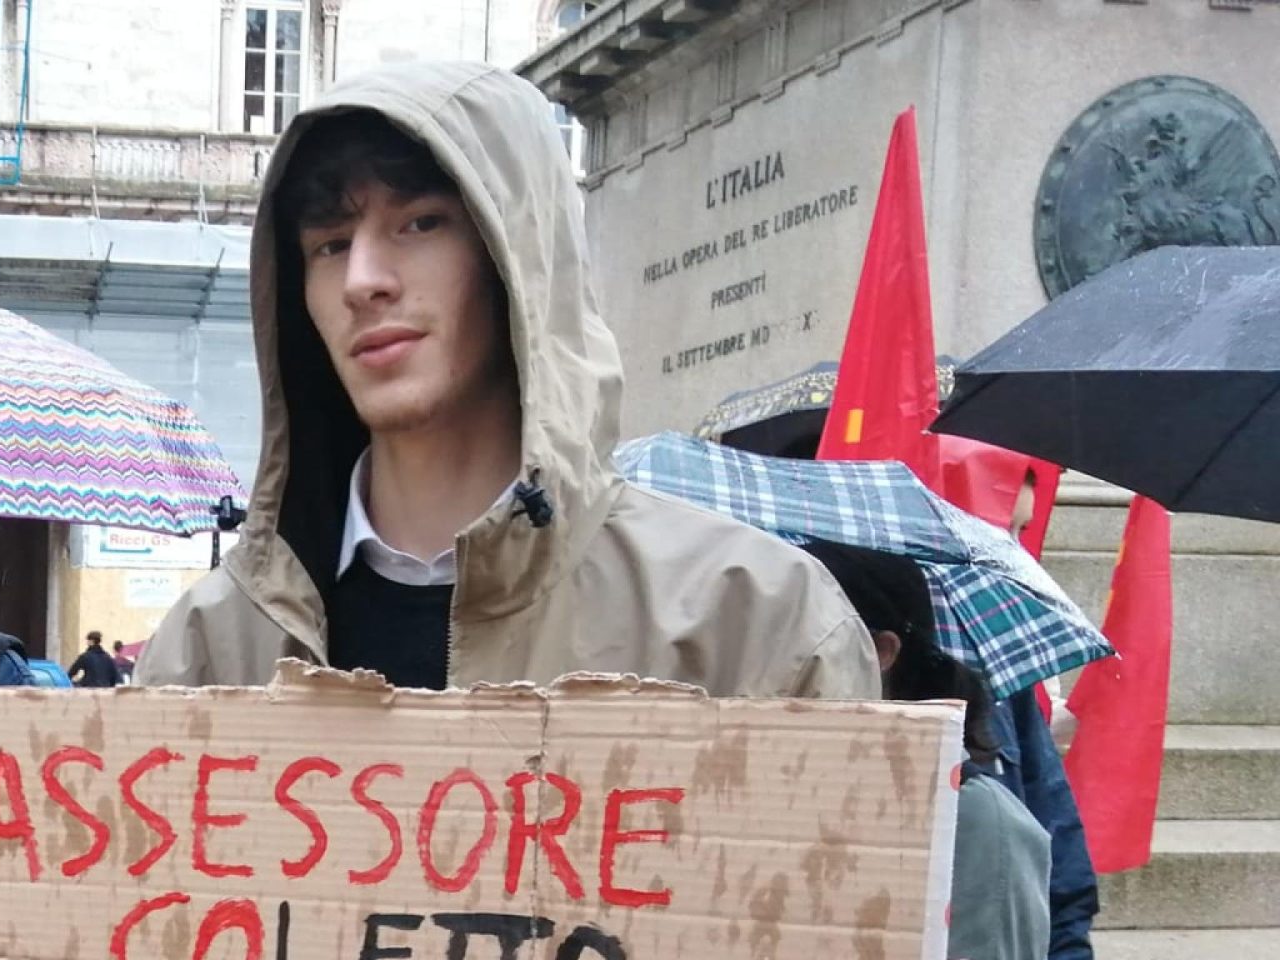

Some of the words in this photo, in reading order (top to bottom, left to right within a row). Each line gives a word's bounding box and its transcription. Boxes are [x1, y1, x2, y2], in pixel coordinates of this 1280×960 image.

[706, 151, 785, 210] L'ITALIA
[643, 256, 678, 285] NELLA
[682, 241, 718, 270] OPERA
[724, 229, 747, 255] DEL
[752, 219, 769, 242] RE
[773, 185, 859, 234] LIBERATORE
[711, 270, 767, 310] PRESENTI
[677, 332, 746, 370] SETTEMBRE
